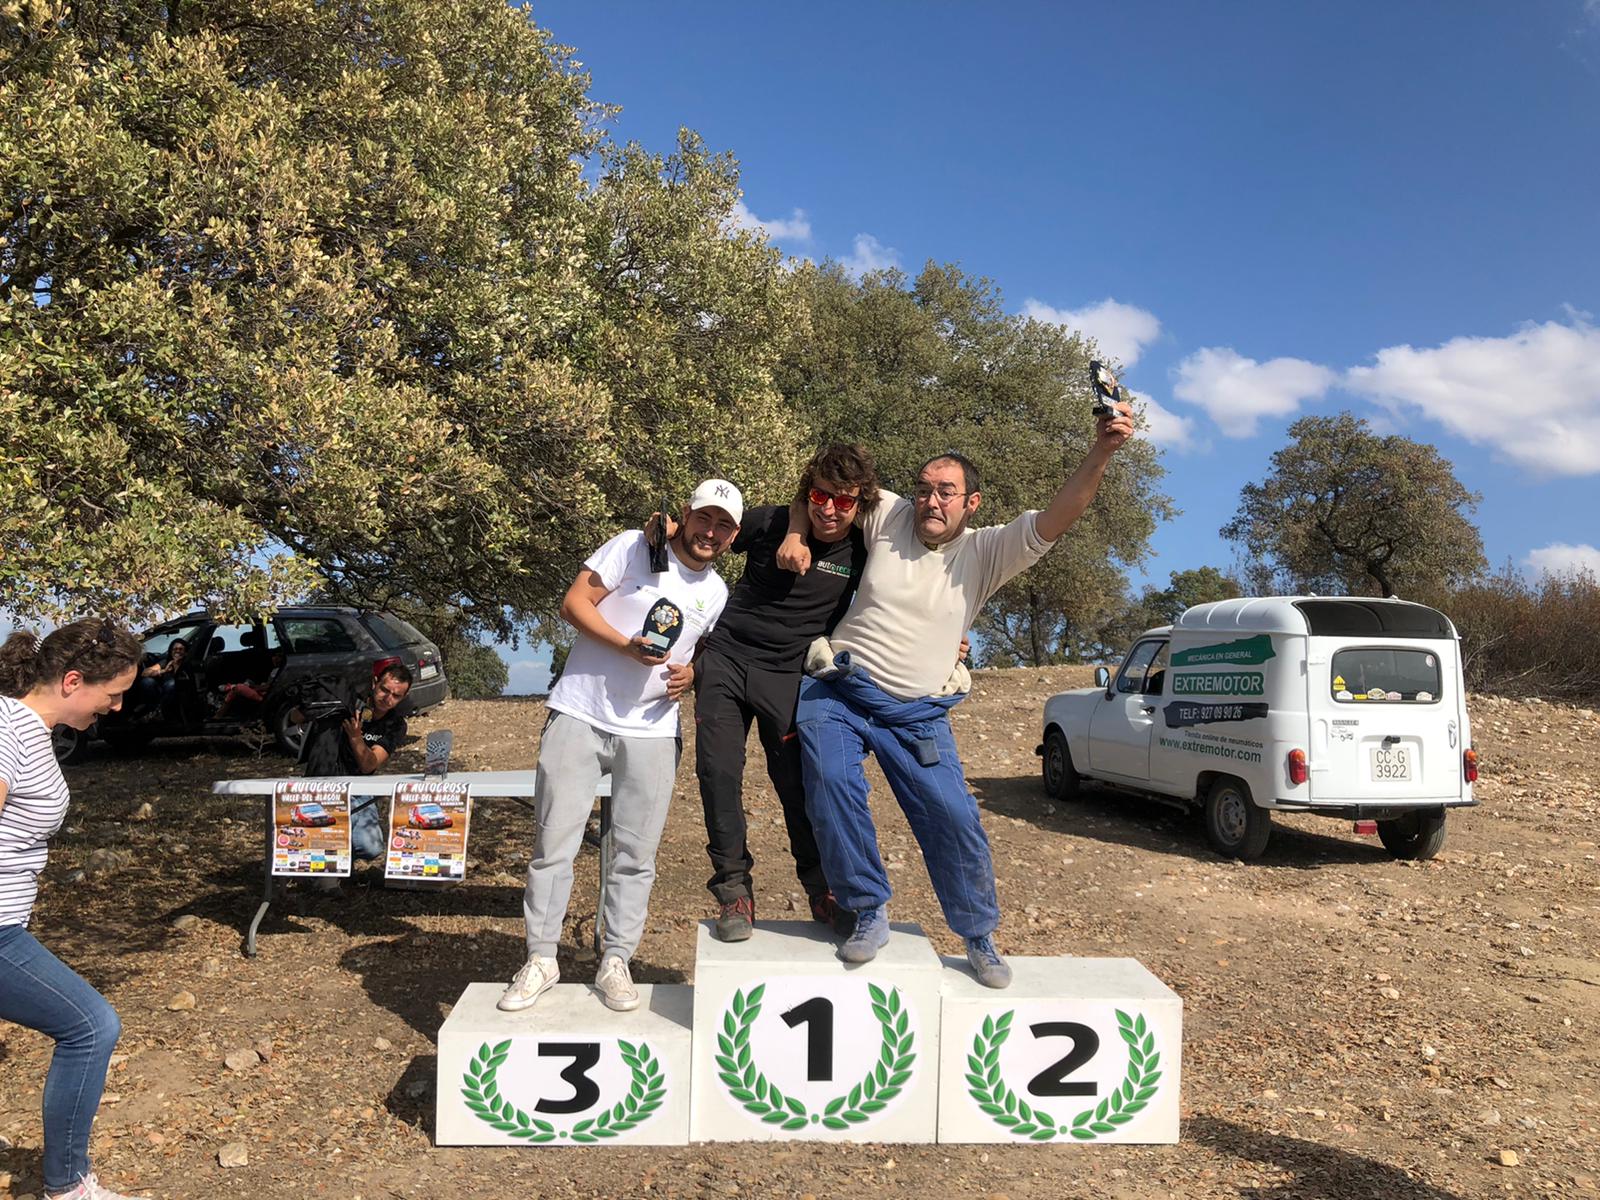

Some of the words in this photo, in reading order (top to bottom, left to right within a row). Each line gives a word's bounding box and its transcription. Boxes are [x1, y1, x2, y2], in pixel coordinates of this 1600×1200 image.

[1216, 652, 1224, 660] EN
[1224, 650, 1252, 660] GENERAL
[1174, 676, 1260, 692] EXTREMOTOR
[1179, 707, 1200, 720] TELF:
[1200, 706, 1213, 719] 927
[1202, 732, 1219, 742] online
[1220, 735, 1228, 743] de
[1159, 737, 1262, 763] www.extremotor.com
[1376, 764, 1407, 778] 3922
[291, 781, 348, 793] AUTOCROSS
[411, 781, 467, 794] AUTOCROSS
[781, 998, 832, 1081] 1
[1028, 1022, 1098, 1096] 2
[535, 1043, 600, 1113] 3
